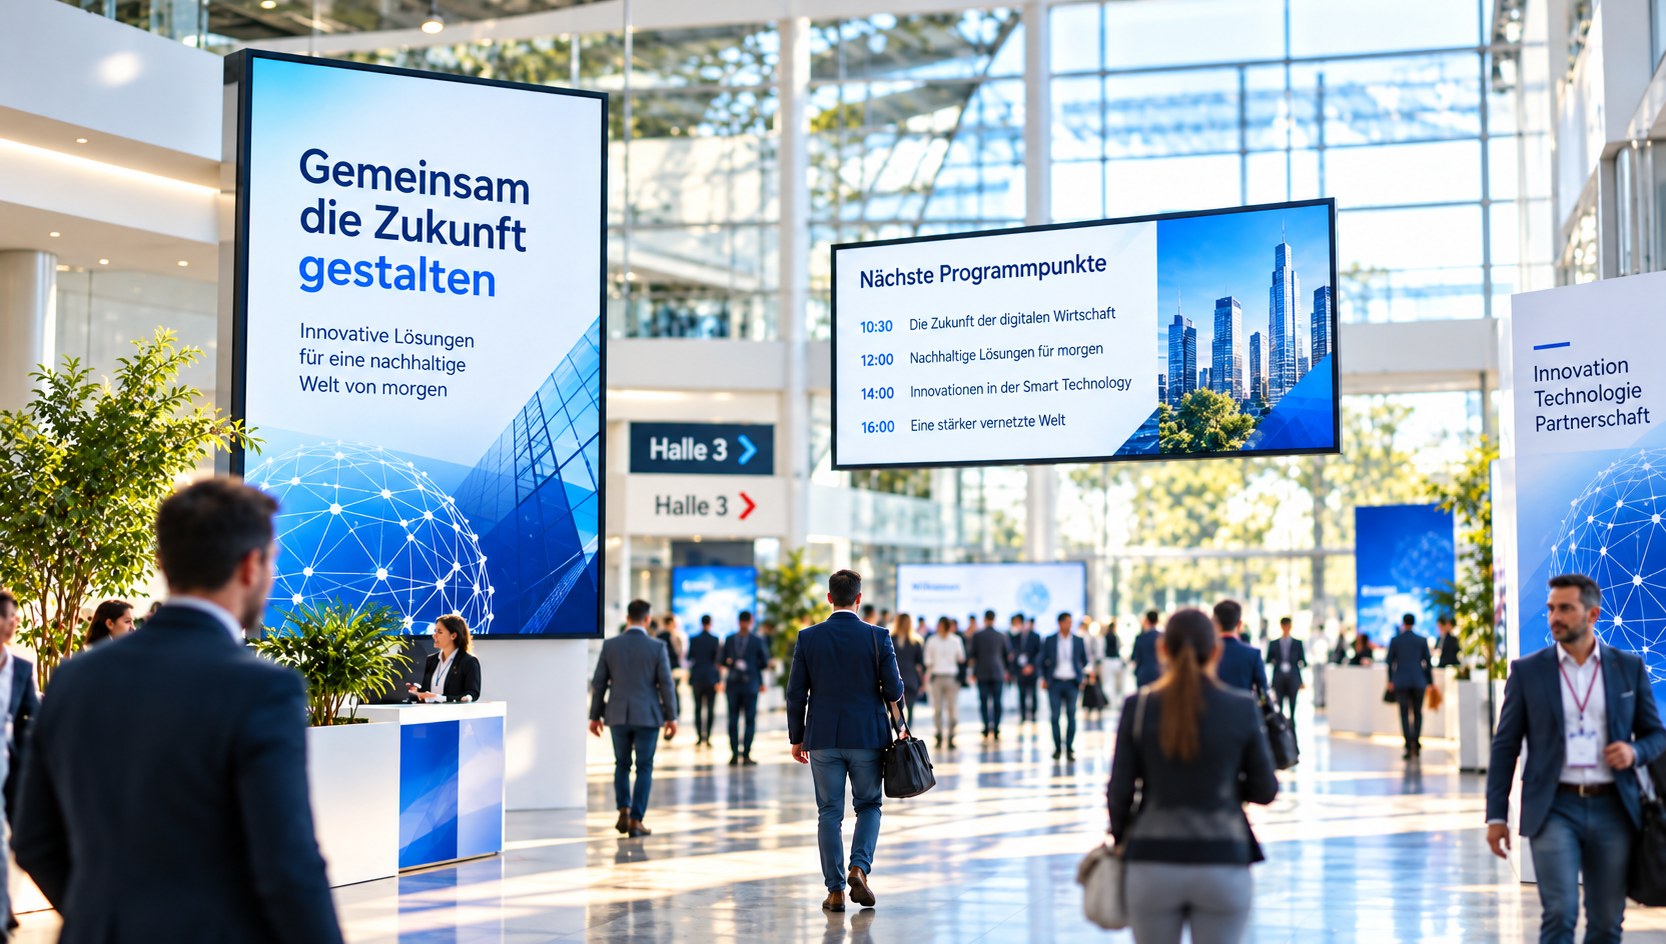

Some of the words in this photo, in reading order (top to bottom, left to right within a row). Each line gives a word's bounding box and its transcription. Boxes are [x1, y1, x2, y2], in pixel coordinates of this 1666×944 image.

[300, 148, 529, 206] Gemeinsam
[301, 198, 361, 237] die
[375, 205, 526, 252] Zukunft
[299, 256, 495, 297] gestalten
[860, 267, 935, 289] Nächste
[940, 254, 1106, 285] Programmpunkte
[860, 319, 894, 334] 10:30
[909, 318, 928, 331] Die
[930, 314, 975, 330] Zukunft
[977, 313, 997, 327] der
[999, 310, 1050, 329] digitalen
[1053, 306, 1117, 323] Wirtschaft
[300, 322, 390, 344] Innovative
[394, 327, 475, 352] Lösungen
[298, 347, 325, 366] für
[329, 350, 366, 368] eine
[370, 353, 467, 376] nachhaltige
[860, 352, 894, 367] 12:00
[910, 349, 977, 365] Nachhaltige
[979, 347, 1035, 362] Lösungen
[1037, 344, 1055, 358] für
[1057, 344, 1104, 359] morgen
[1534, 357, 1629, 383] Innovation
[298, 375, 340, 393] Welt
[344, 381, 377, 395] von
[382, 382, 448, 401] morgen
[861, 386, 895, 401] 14:00
[910, 384, 984, 398] Innovationen
[986, 381, 998, 395] in
[1000, 380, 1021, 394] der
[1023, 379, 1059, 393] Smart
[1061, 375, 1133, 392] Technology
[1533, 381, 1642, 408] Technologie
[861, 420, 895, 434] 16:00
[910, 418, 935, 432] Eine
[937, 417, 978, 431] stärker
[979, 415, 1036, 429] vernetzte
[1038, 413, 1066, 427] Welt
[1535, 406, 1651, 433] Partnerschaft
[649, 436, 709, 462] Halle
[712, 437, 728, 462] 3
[655, 494, 710, 517] Halle
[715, 495, 729, 517] 3
